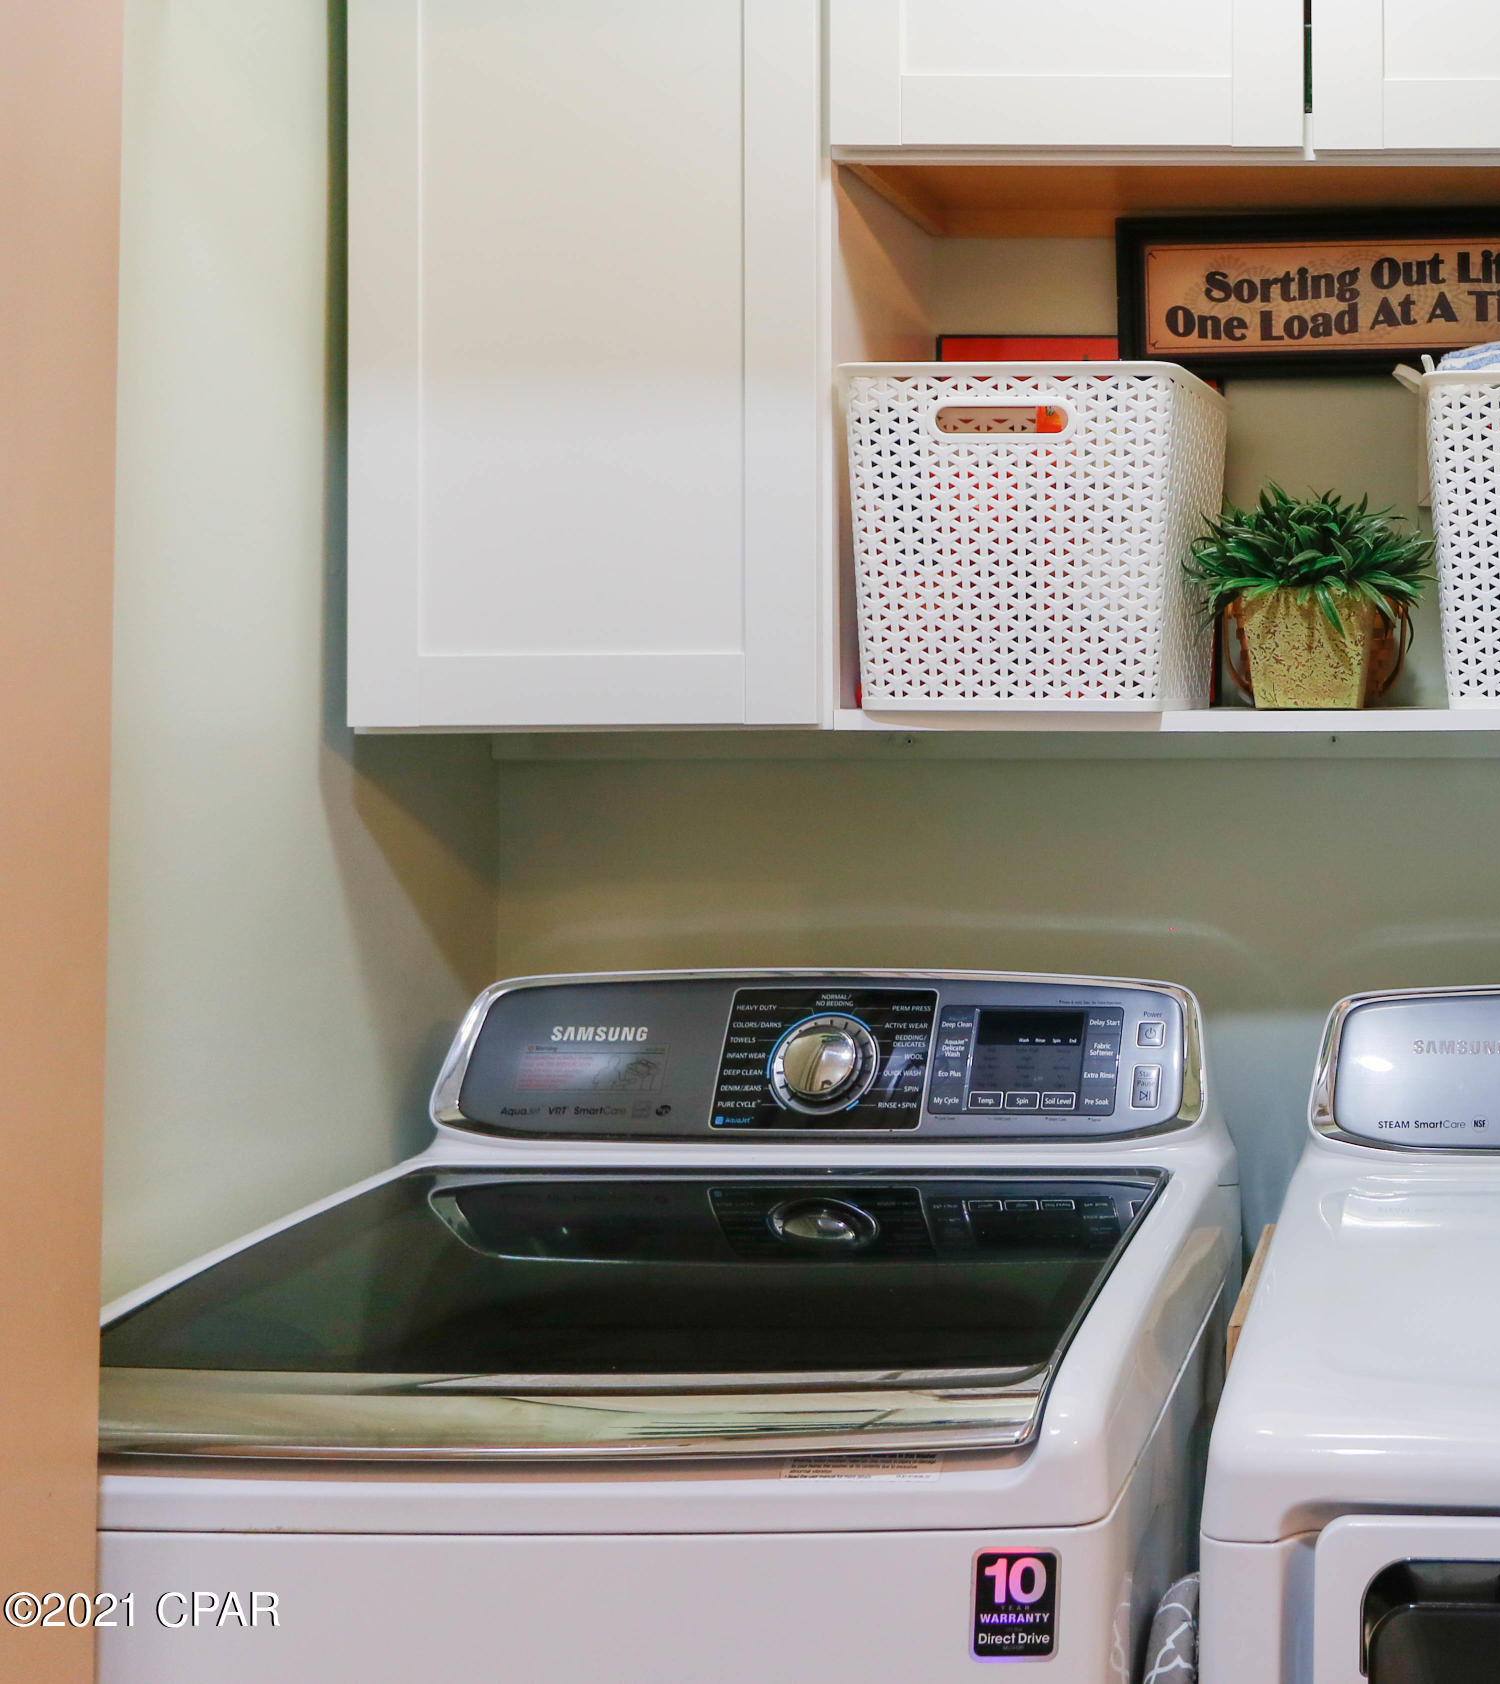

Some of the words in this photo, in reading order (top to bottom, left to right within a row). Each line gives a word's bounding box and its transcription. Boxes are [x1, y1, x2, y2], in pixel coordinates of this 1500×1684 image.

[1204, 267, 1360, 303] Sorting
[1370, 253, 1446, 290] Out
[1165, 305, 1248, 341] One
[1260, 302, 1359, 341] Load
[1369, 293, 1418, 330] At
[1426, 291, 1459, 324] A
[736, 1004, 758, 1012] HEAVY
[759, 1004, 777, 1012] DUTY
[941, 1021, 956, 1029] Deep
[1089, 1019, 1106, 1027] Delay
[550, 1025, 649, 1042] SAMSUNG
[903, 1085, 920, 1093] SPIN
[1016, 1097, 1029, 1106] Spin
[1045, 1097, 1056, 1105] Soil
[1056, 1097, 1072, 1105] Level
[1378, 1120, 1410, 1129] STEAM
[1414, 1119, 1466, 1129] SmartCare
[1473, 1119, 1486, 1128] NSF
[984, 1556, 1047, 1605] 10
[980, 1612, 1050, 1624] WARRANTY
[978, 1633, 1016, 1644] Direct
[1018, 1632, 1050, 1644] Drive
